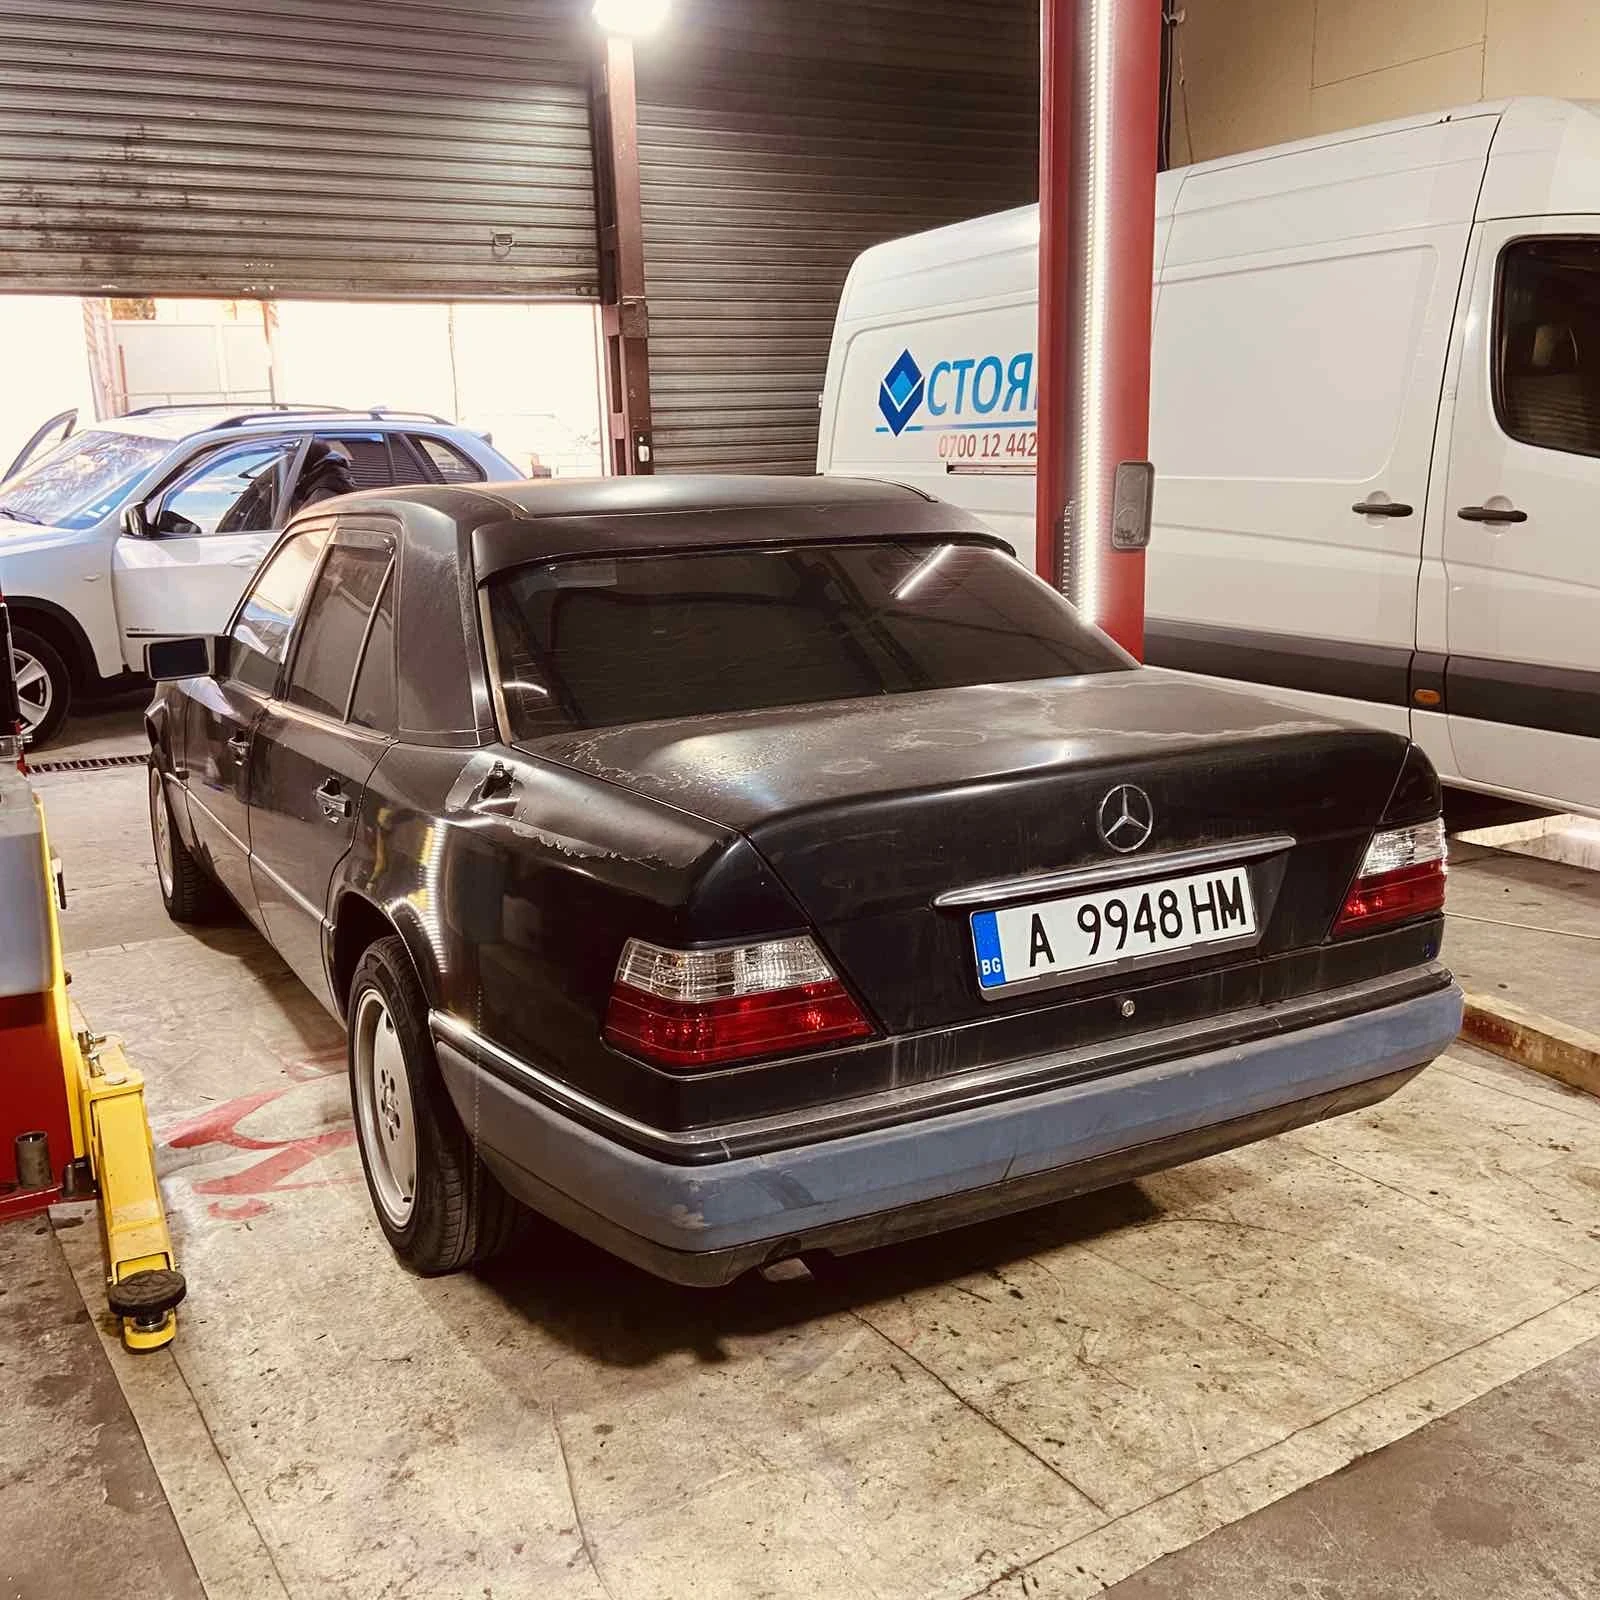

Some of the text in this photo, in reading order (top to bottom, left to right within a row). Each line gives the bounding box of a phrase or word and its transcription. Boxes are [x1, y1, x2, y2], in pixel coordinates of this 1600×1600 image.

[927, 352, 1037, 416] СТОЯ
[938, 431, 1037, 458] 0700 12 442
[1029, 876, 1247, 968] A 9948 HM
[981, 957, 1001, 976] BG
